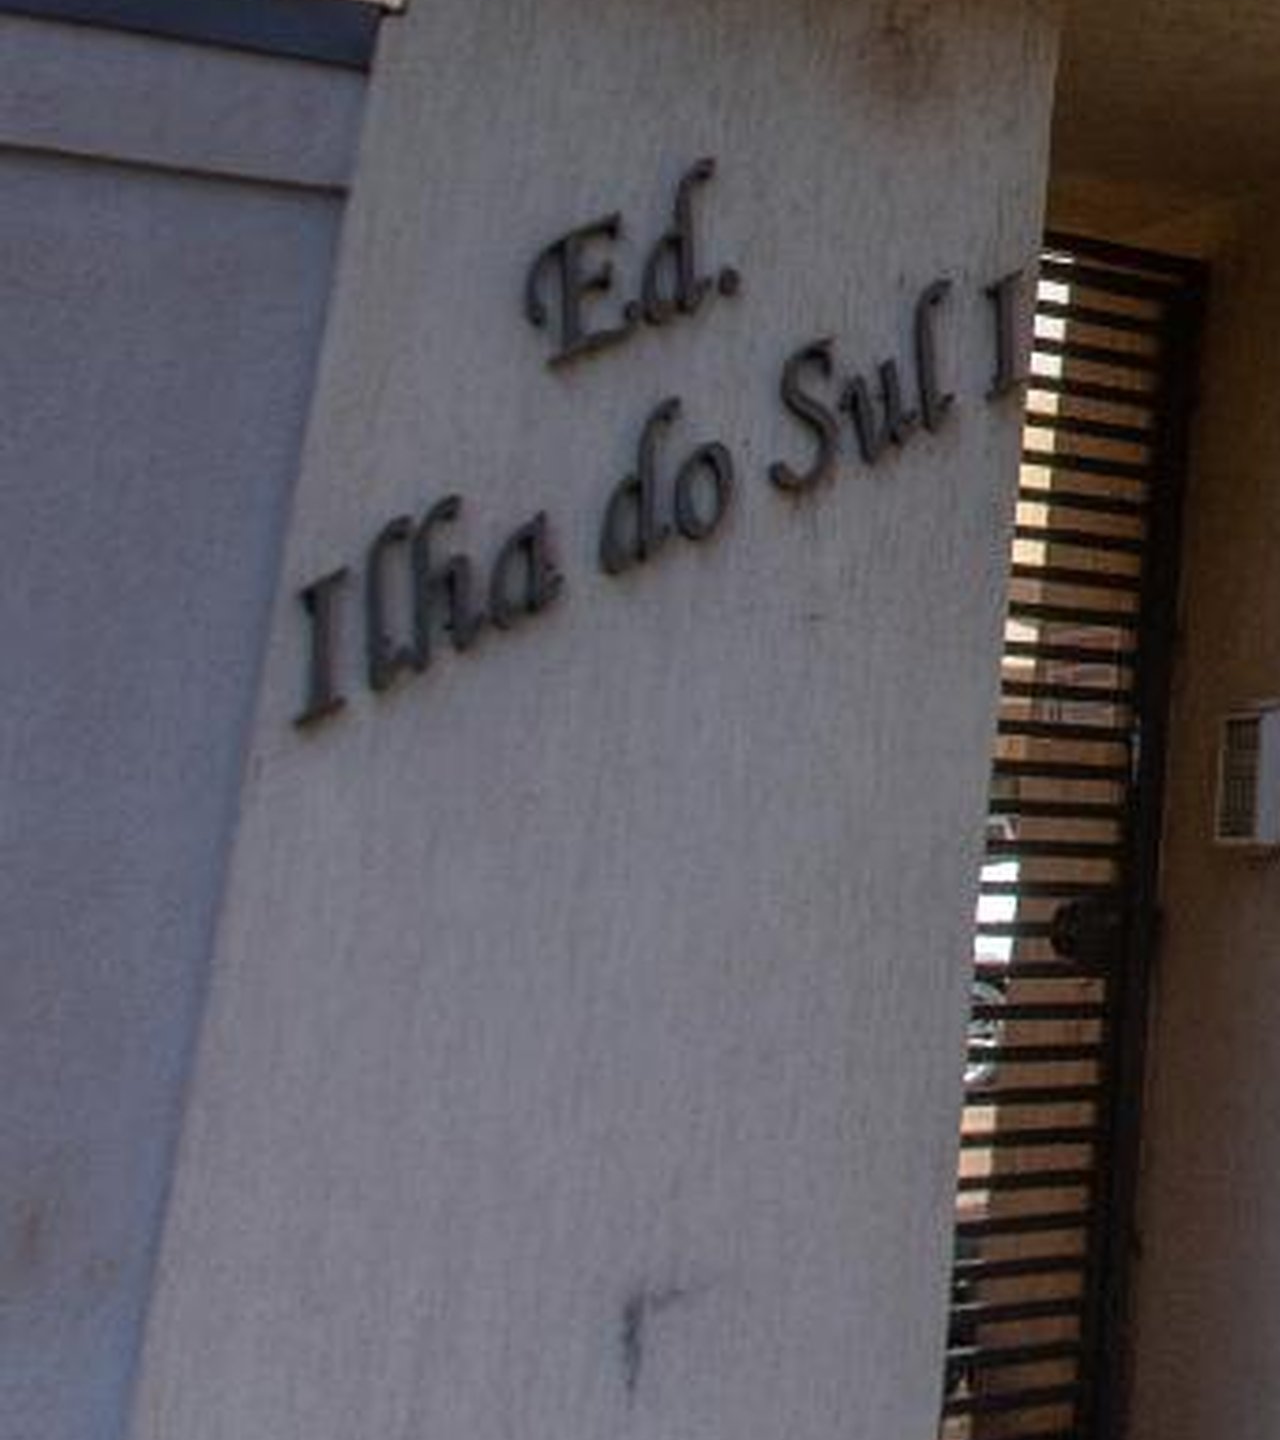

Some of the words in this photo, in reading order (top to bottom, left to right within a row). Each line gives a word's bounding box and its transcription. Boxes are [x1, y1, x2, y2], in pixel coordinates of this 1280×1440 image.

[524, 156, 741, 370] Ed.
[295, 494, 564, 730] Ilha
[601, 396, 733, 577] do
[769, 279, 955, 494] Sul
